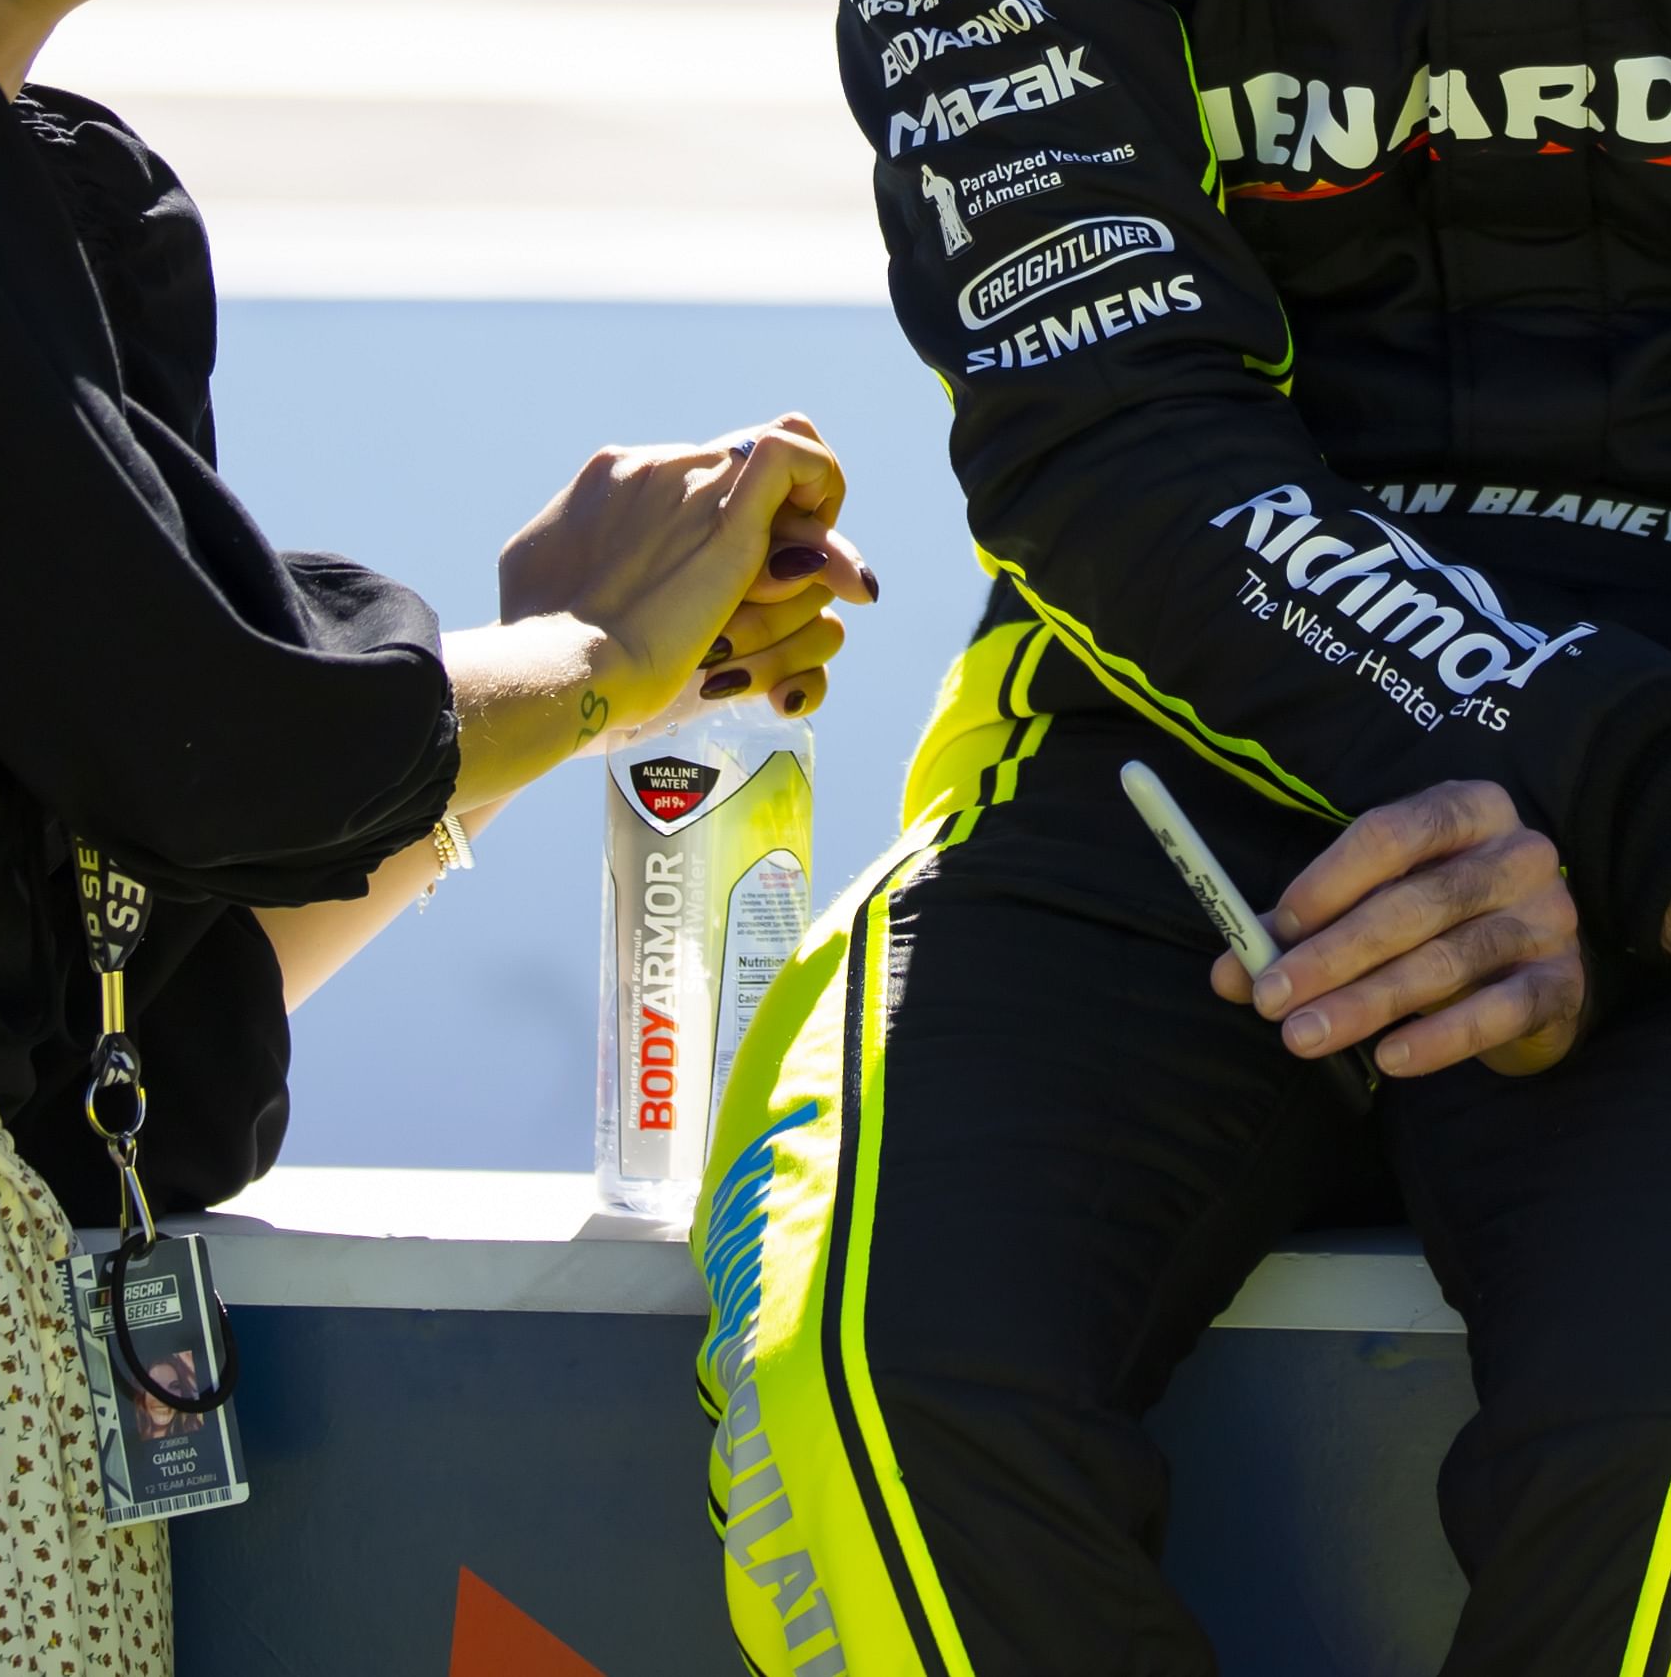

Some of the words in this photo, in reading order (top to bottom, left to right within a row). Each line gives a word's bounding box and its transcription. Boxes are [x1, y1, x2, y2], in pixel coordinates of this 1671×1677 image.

[889, 46, 1105, 158] Mazak
[960, 150, 1048, 197] Paralyzed
[1049, 142, 1136, 163] Veterans
[968, 198, 983, 216] of
[985, 171, 1063, 210] America
[977, 225, 1155, 316] FREIGHTLINER
[966, 274, 1202, 374] SIEMENS
[1368, 484, 1457, 514] AN
[1236, 568, 1279, 622] The
[1282, 600, 1358, 666] Water
[643, 766, 699, 779] ALKALINE
[650, 778, 689, 790] WATER
[630, 928, 643, 982] Formula
[639, 851, 685, 1131] BODYARMOR
[629, 984, 641, 1054] Electrolyte
[628, 1056, 640, 1129] Proprietary
[124, 1281, 163, 1301] ASCAR
[128, 1300, 168, 1320] SERIES
[152, 1446, 198, 1465] GIANNA
[160, 1461, 196, 1477] TULIO
[144, 1484, 156, 1494] 12
[158, 1478, 184, 1491] TEAM
[186, 1473, 217, 1486] ADMIN
